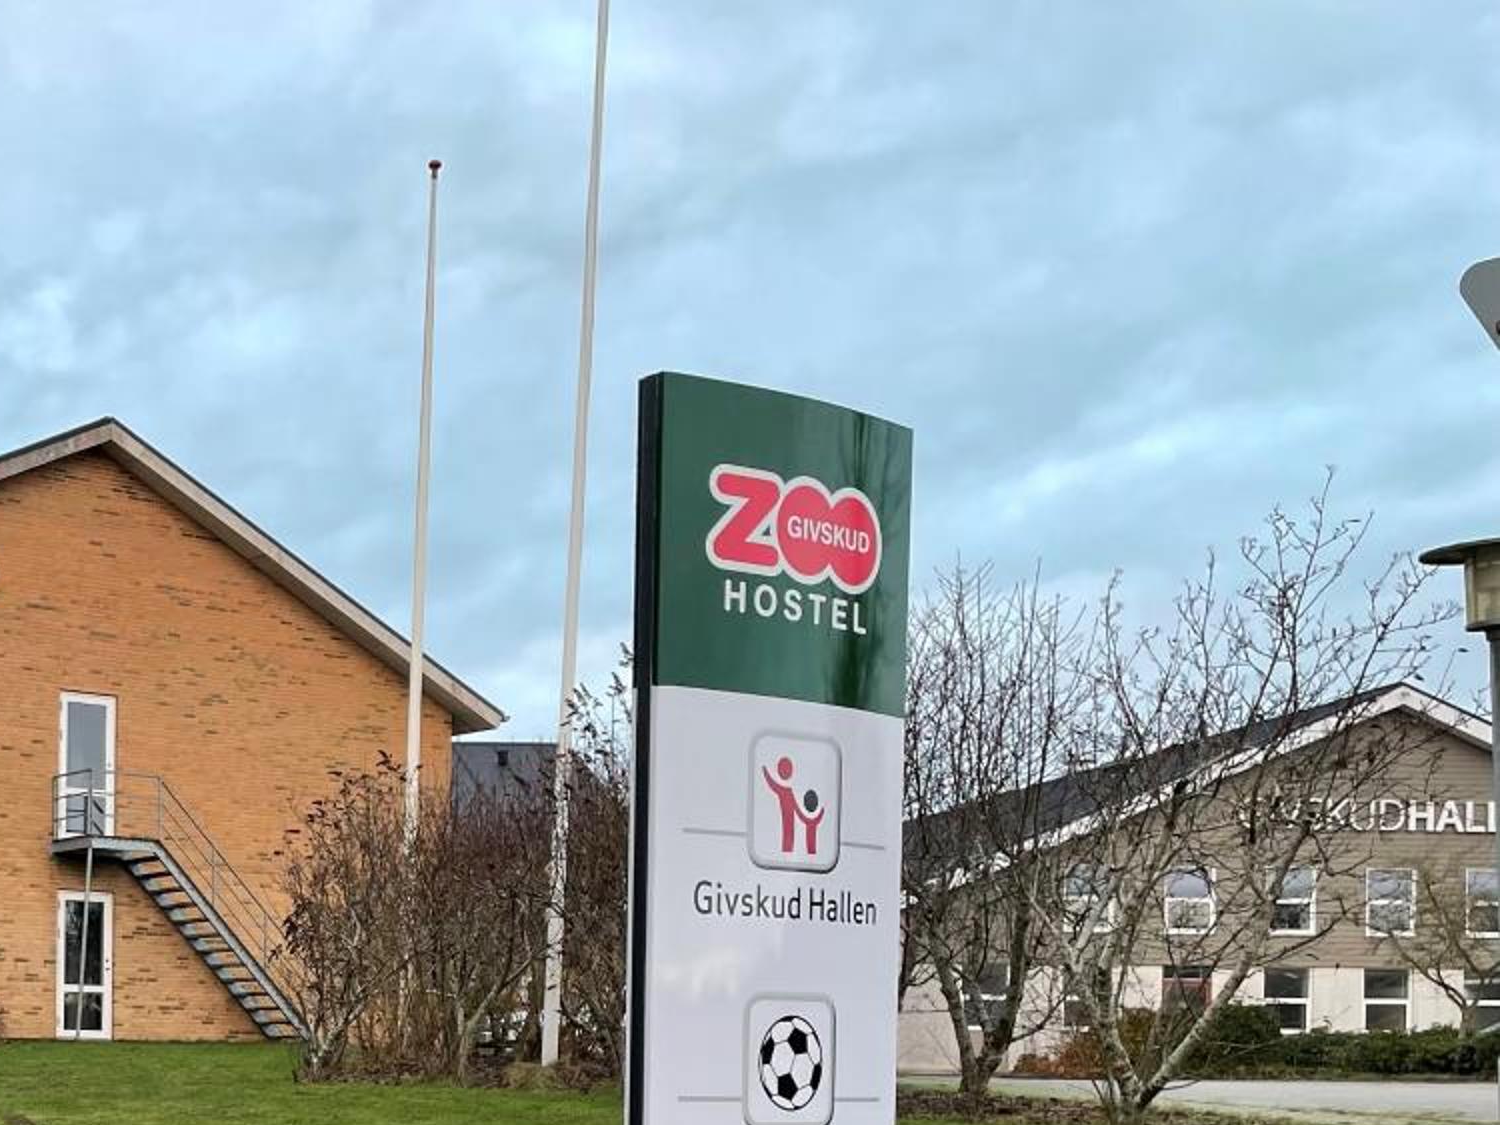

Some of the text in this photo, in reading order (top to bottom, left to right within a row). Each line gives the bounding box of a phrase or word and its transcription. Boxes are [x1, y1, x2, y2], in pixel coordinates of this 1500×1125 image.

[712, 472, 878, 588] ZOO
[786, 514, 871, 555] GIVSKUD
[723, 578, 868, 636] HOSTEL
[693, 879, 877, 925] Givskud Hallen
